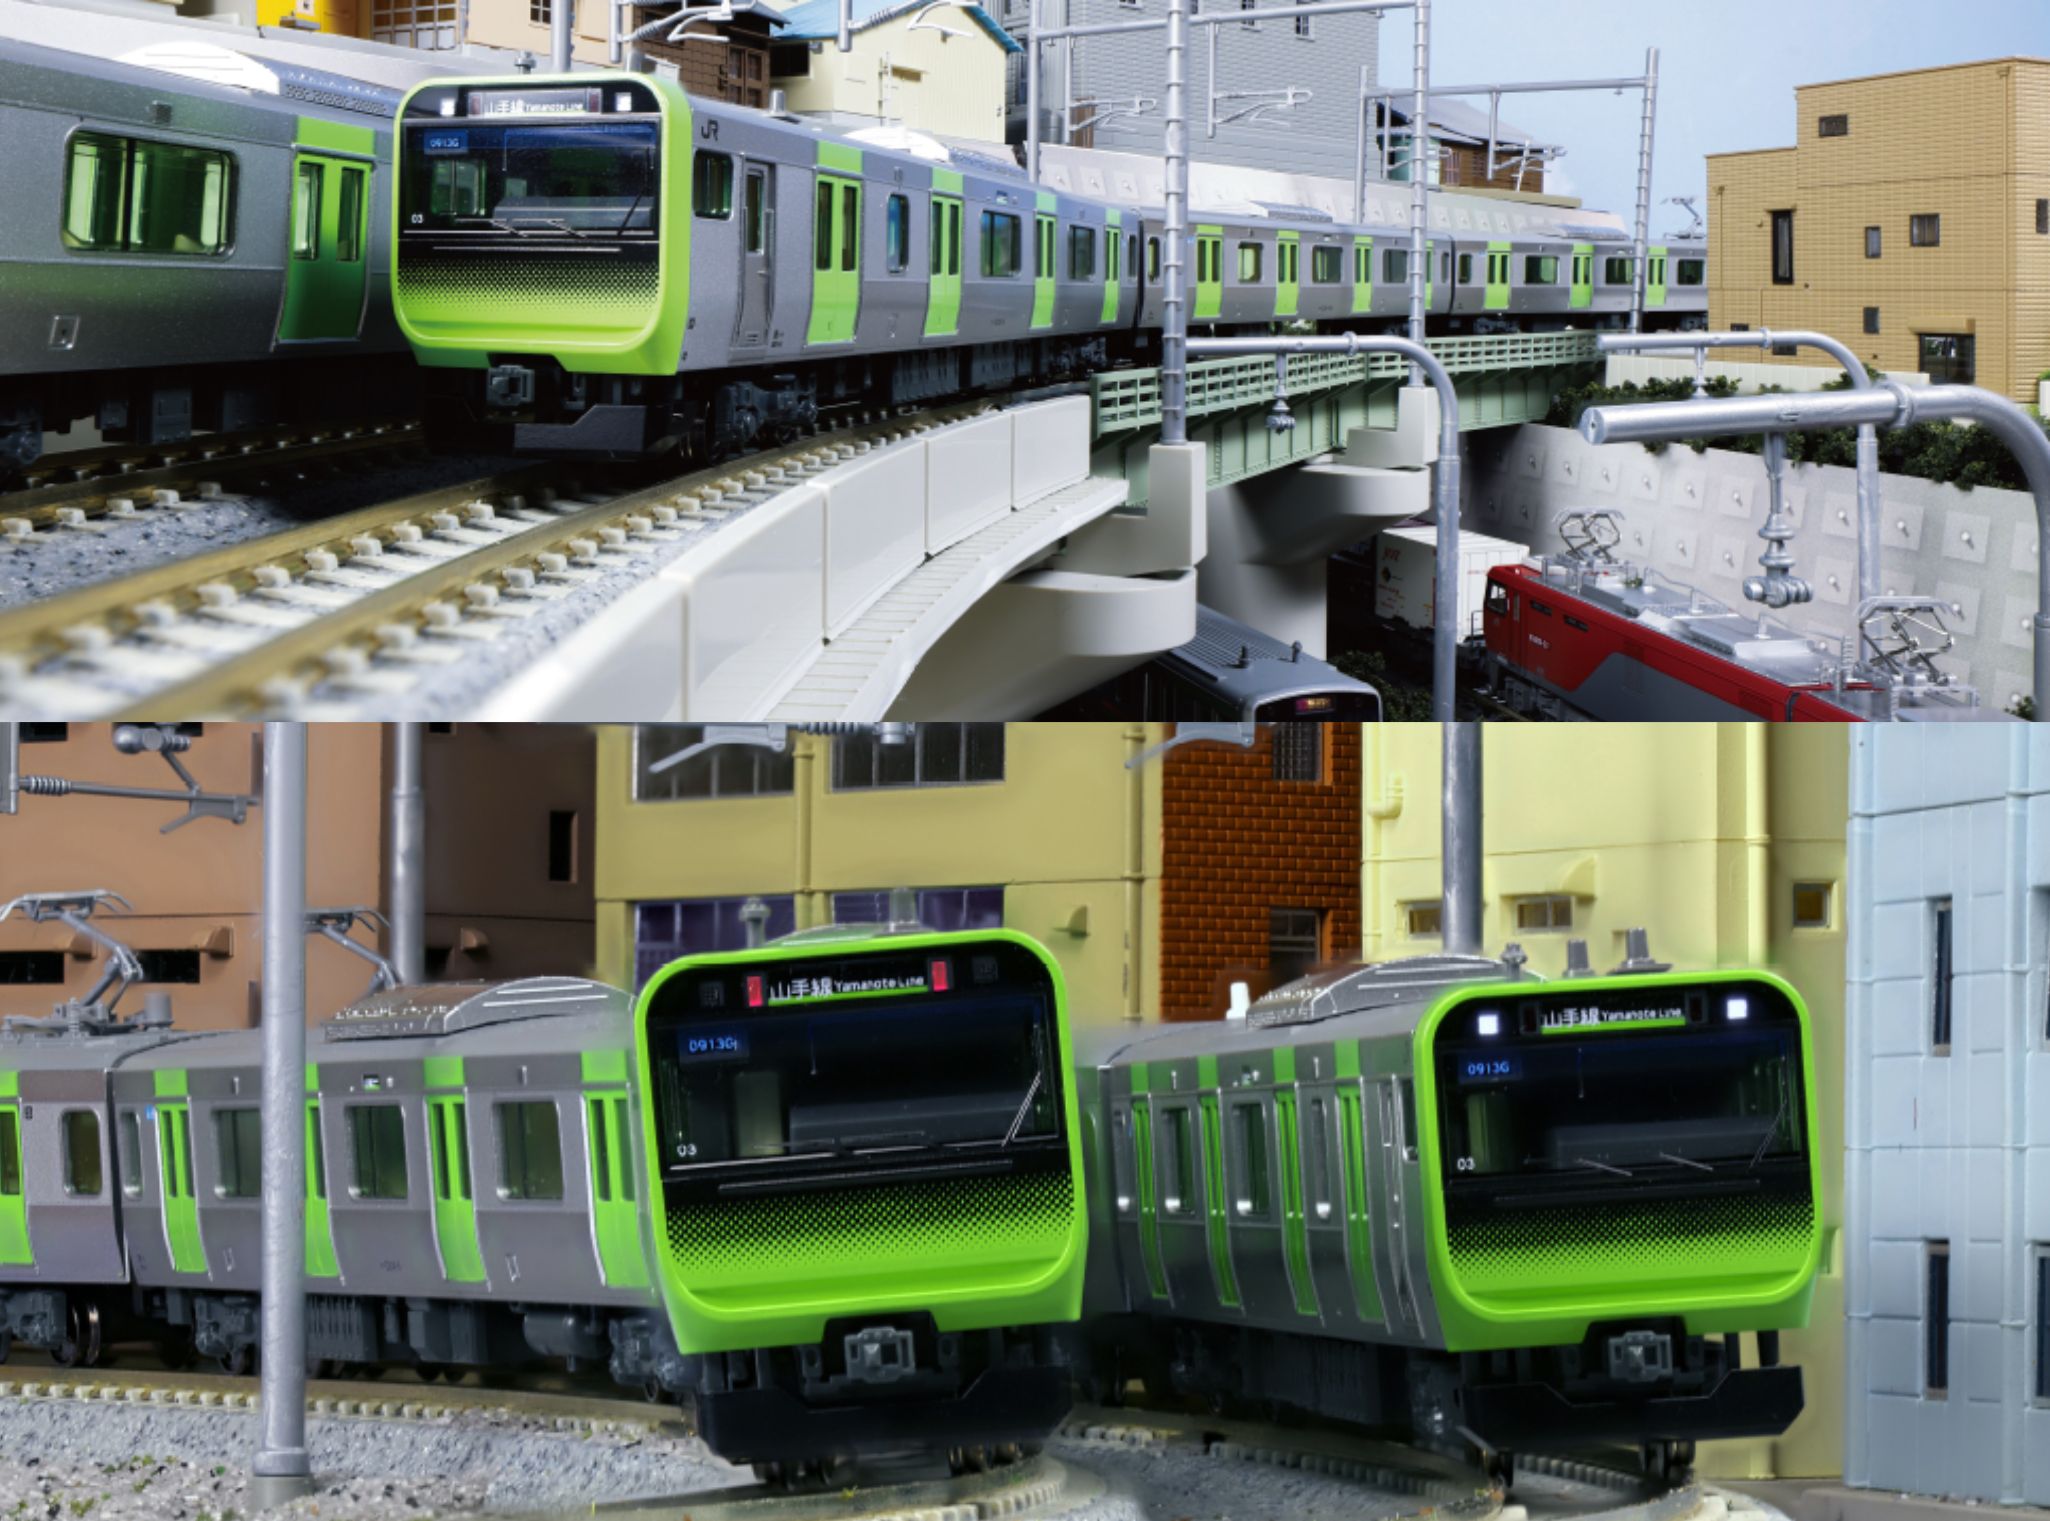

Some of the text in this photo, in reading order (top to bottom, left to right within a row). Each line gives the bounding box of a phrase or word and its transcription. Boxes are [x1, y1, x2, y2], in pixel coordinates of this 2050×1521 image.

[701, 119, 718, 141] JR
[769, 975, 925, 1001] 山手線 Yamanote Line
[1542, 1006, 1600, 1028] 山手線
[1601, 1009, 1656, 1022] Yamanote
[677, 1143, 697, 1158] 03
[1457, 1156, 1475, 1171] 03
